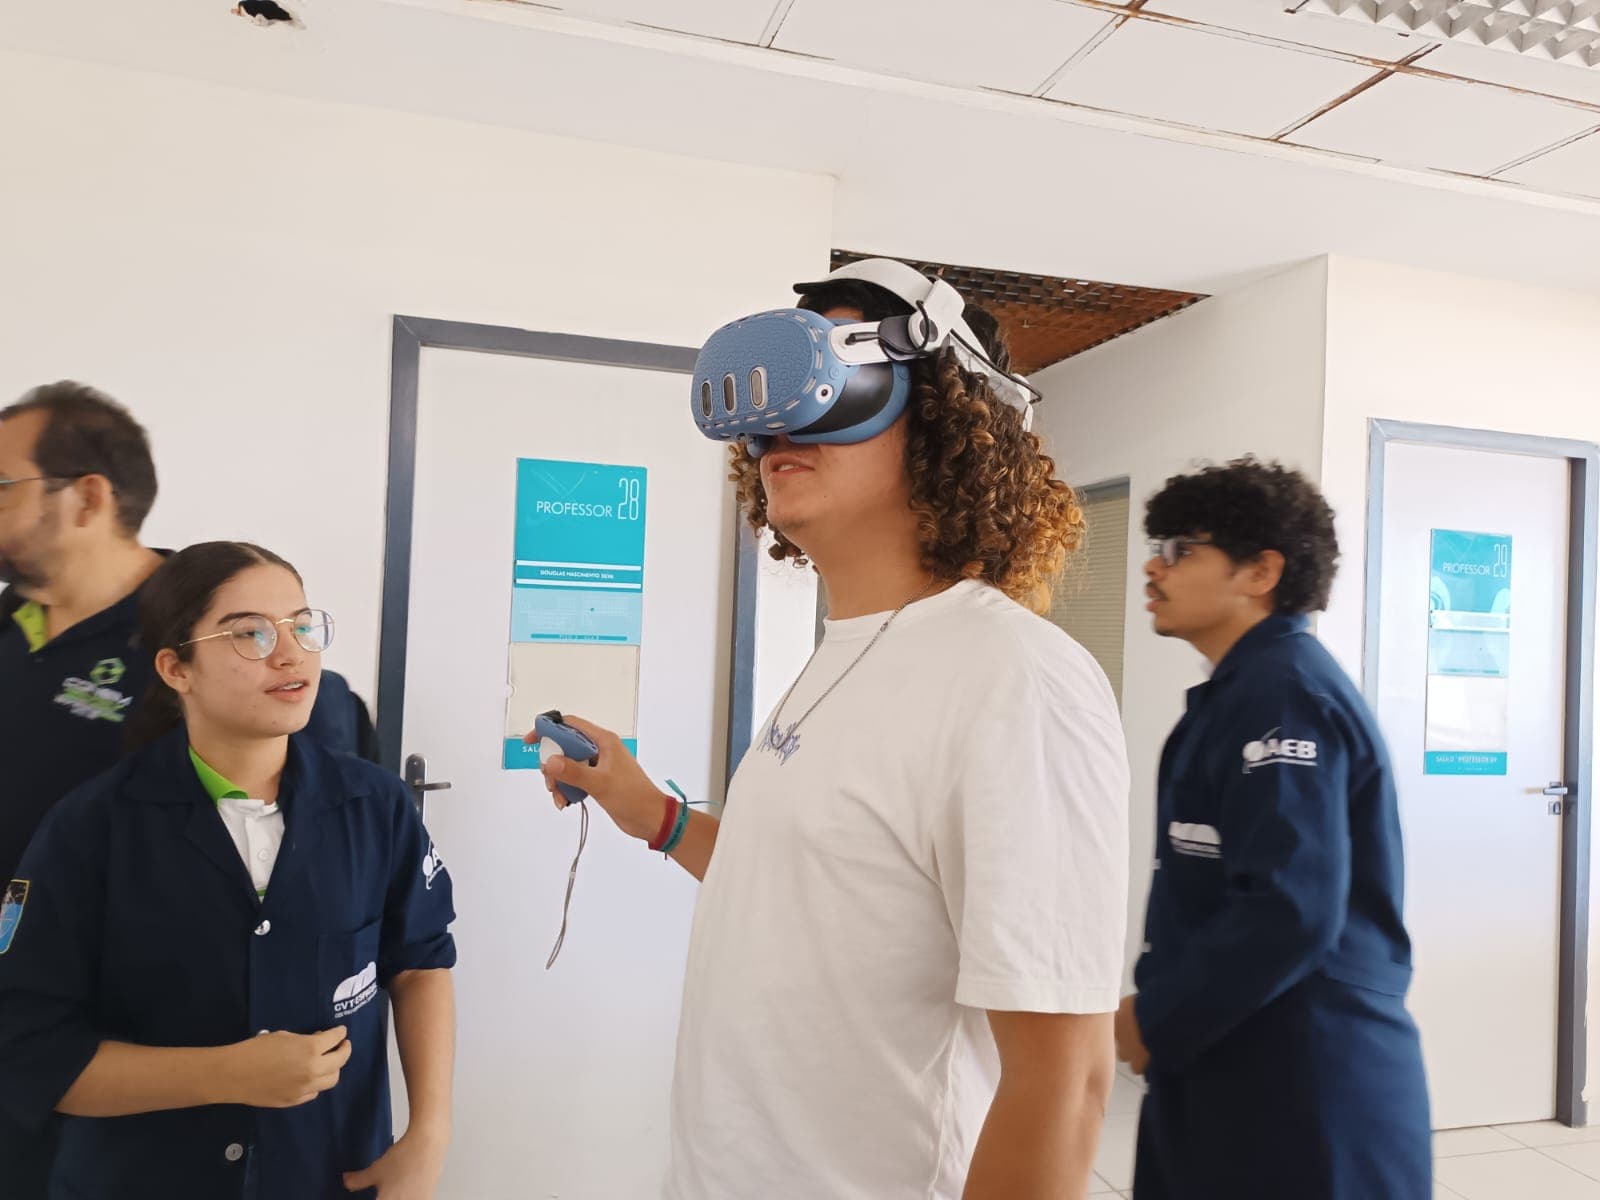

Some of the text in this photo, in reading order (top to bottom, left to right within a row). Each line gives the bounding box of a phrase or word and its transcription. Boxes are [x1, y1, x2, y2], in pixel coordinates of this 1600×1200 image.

[536, 477, 640, 521] PROFESSOR 28
[1442, 543, 1508, 578] PROFESSOR 29
[540, 569, 565, 577] DOUGLAS
[522, 745, 539, 753] SAL
